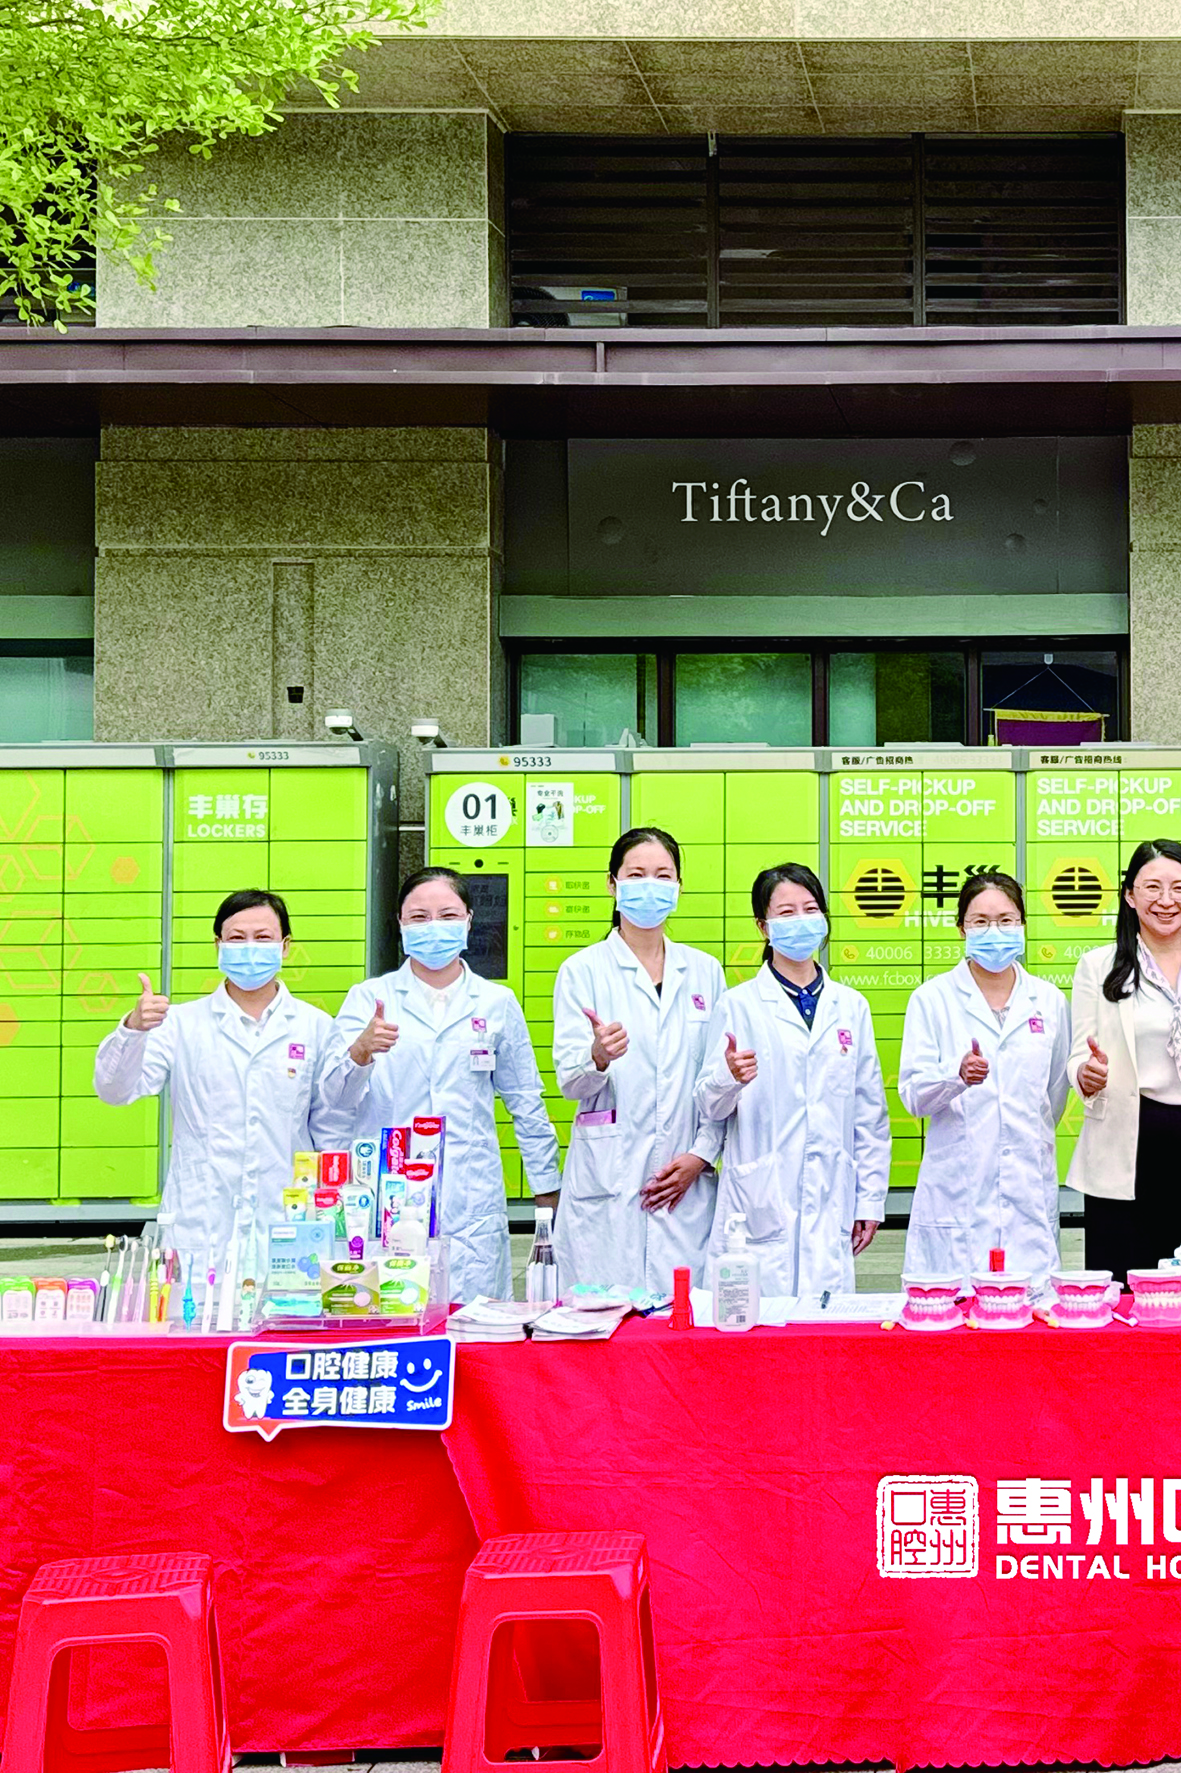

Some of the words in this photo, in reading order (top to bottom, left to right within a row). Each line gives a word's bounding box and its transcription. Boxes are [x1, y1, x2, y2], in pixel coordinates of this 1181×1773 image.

[672, 478, 954, 537] Tiftany&Ca
[258, 751, 289, 760] 95333
[514, 756, 552, 767] 95333
[839, 778, 976, 795] SELF-PICKUP
[1037, 778, 1173, 795] SELF-PICKUP
[187, 793, 269, 820] 丰巢存
[462, 793, 498, 820] 01
[839, 799, 884, 816] AND
[889, 799, 997, 816] DROP-OFF
[1037, 798, 1081, 815] AND
[187, 823, 267, 839] LOCKERS
[460, 824, 498, 837] 丰巢柜
[839, 820, 928, 837] SERVICE
[1037, 818, 1125, 836] SERVICE
[865, 946, 913, 960] 40006
[924, 946, 965, 960] 3333
[285, 1350, 399, 1380] 口腔健康
[281, 1385, 397, 1415] 全身健康
[406, 1396, 442, 1412] Smile
[996, 1555, 1131, 1580] DENTAL
